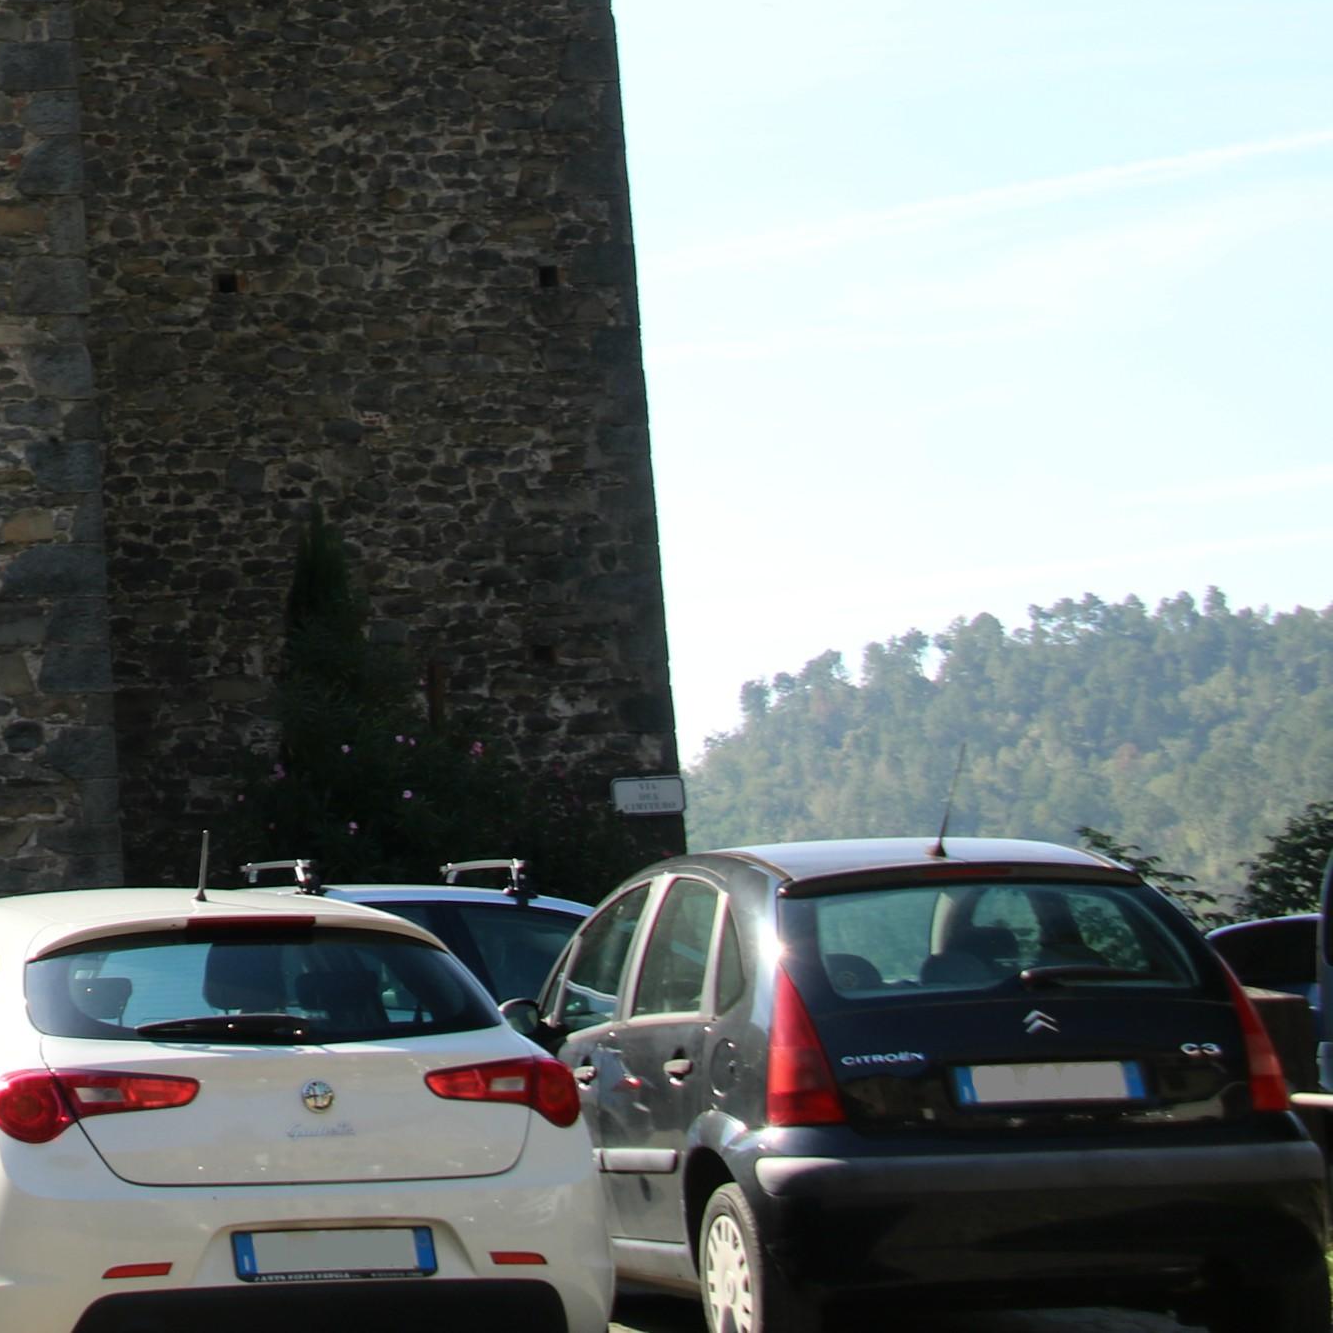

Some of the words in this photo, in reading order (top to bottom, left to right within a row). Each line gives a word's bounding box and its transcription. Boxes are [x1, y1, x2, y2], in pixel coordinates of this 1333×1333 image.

[638, 782, 657, 790] VIA
[1180, 1042, 1221, 1055] C3
[840, 1051, 925, 1066] CITROËN
